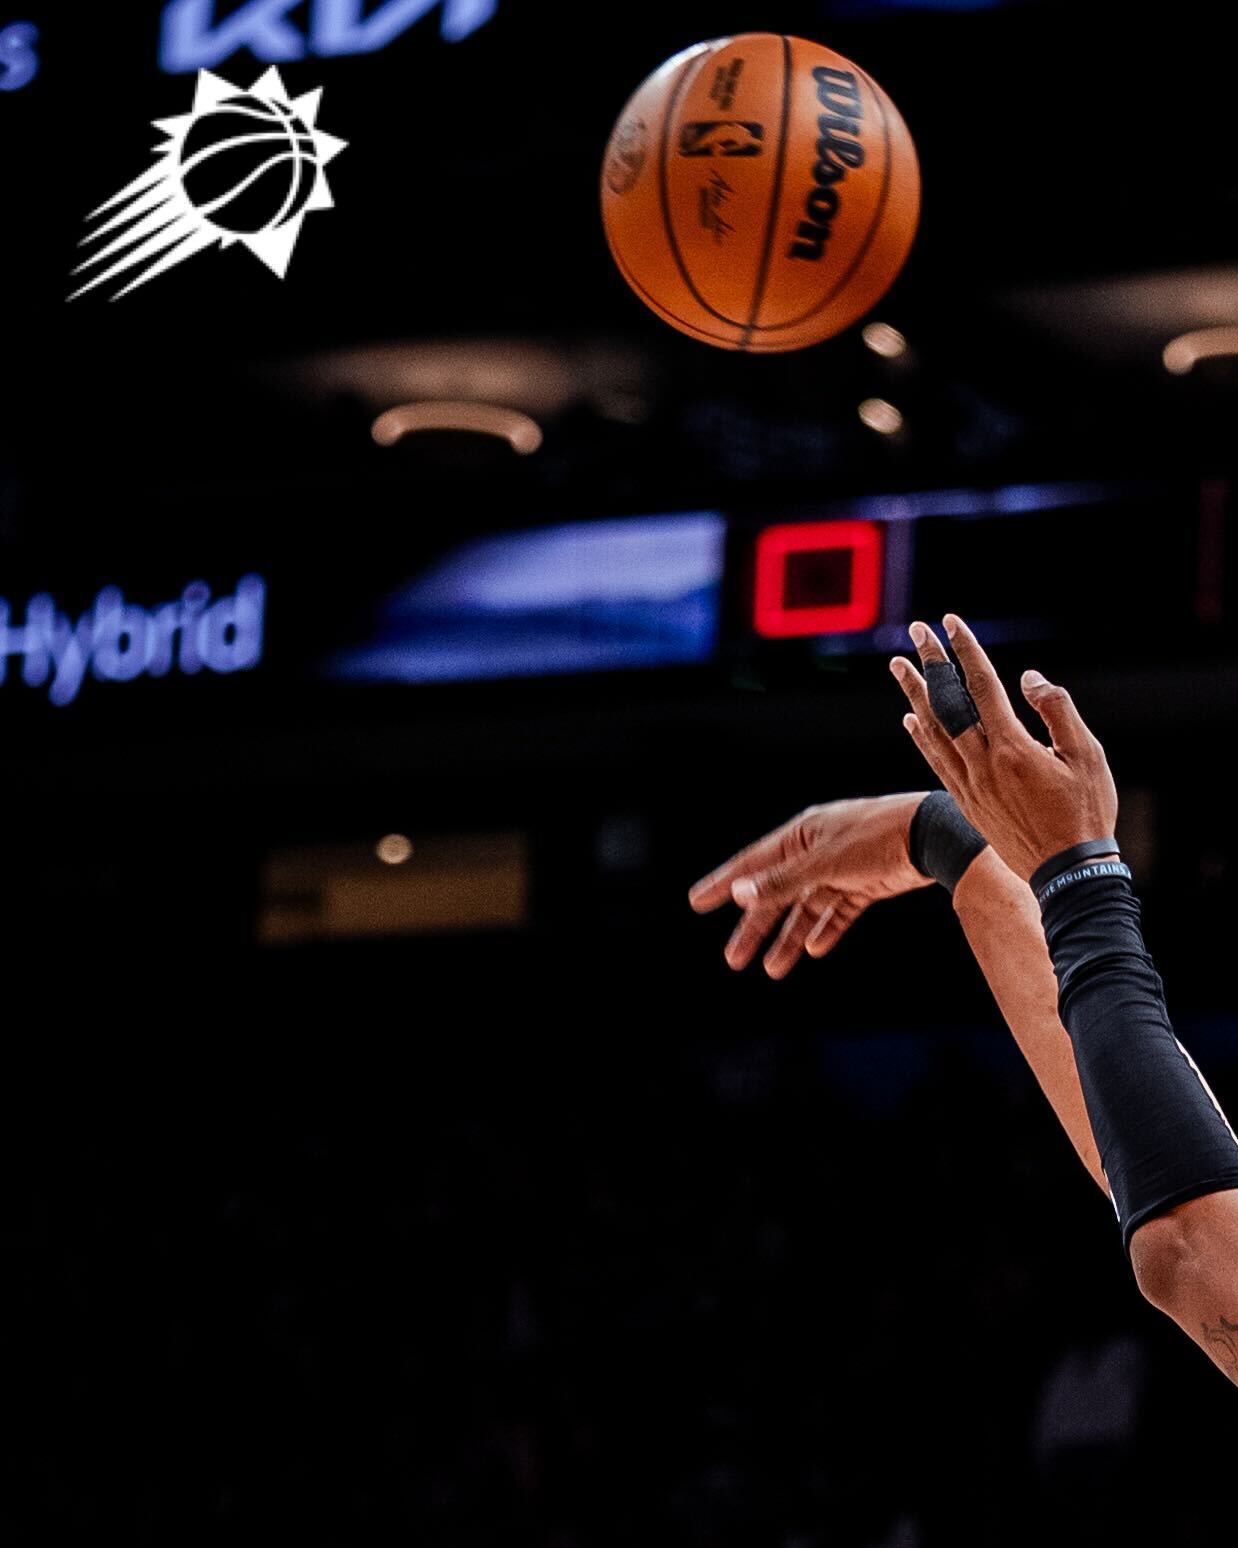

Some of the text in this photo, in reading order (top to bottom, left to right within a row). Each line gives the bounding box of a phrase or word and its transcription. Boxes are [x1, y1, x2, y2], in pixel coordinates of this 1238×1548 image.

[786, 65, 865, 262] Wilson
[0, 572, 267, 707] Hybrid
[1056, 863, 1125, 888] MOUNTAINS
